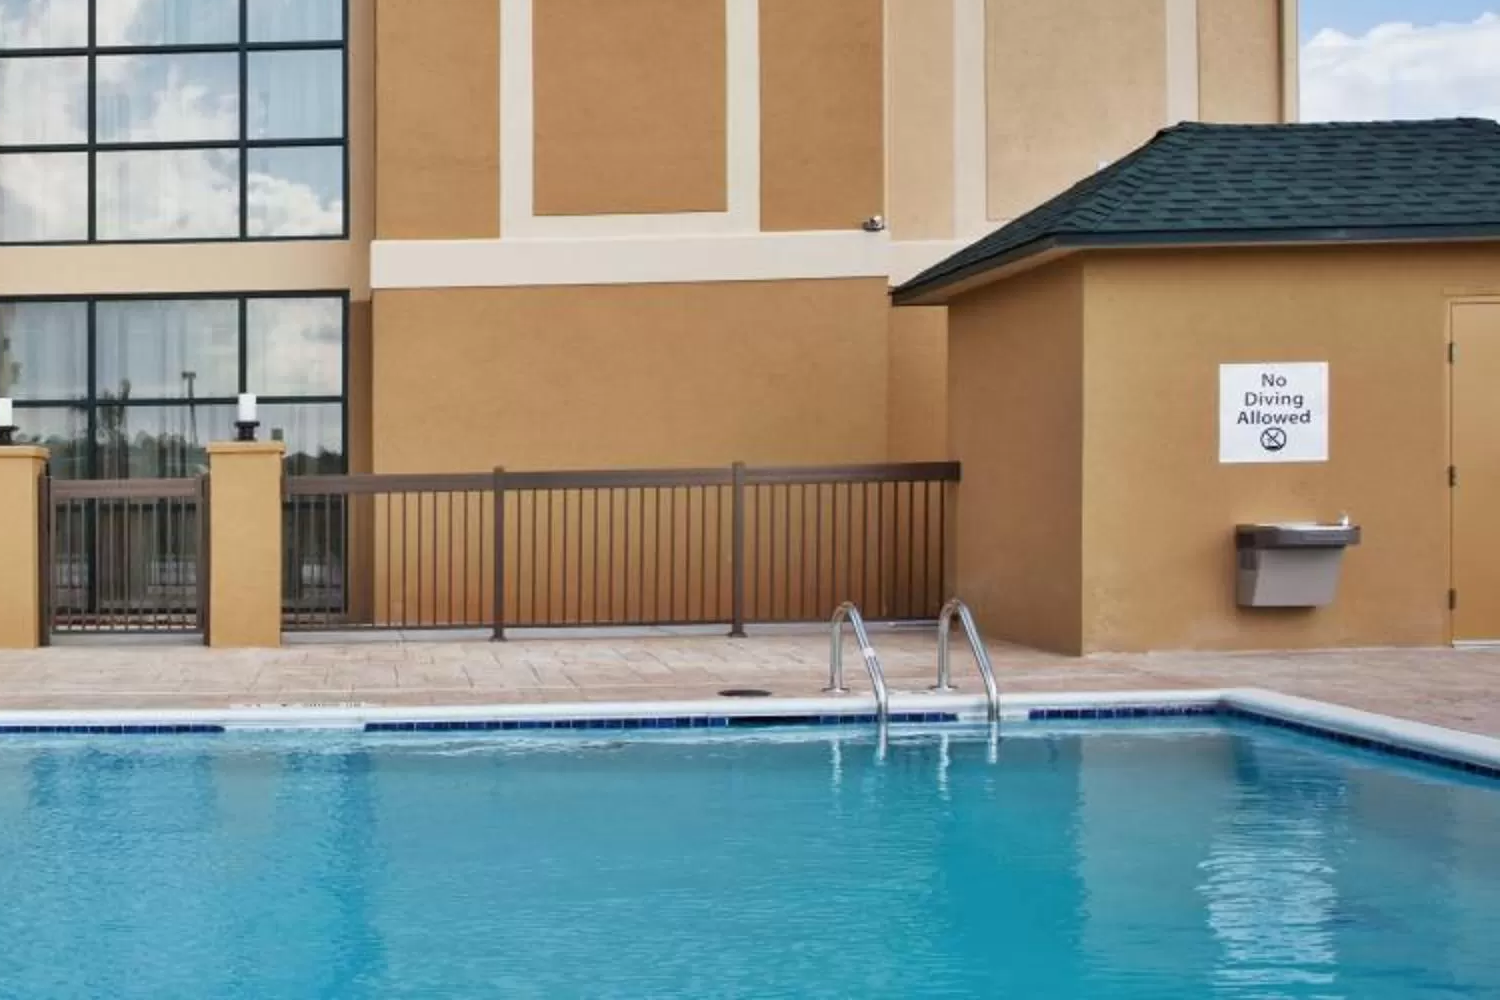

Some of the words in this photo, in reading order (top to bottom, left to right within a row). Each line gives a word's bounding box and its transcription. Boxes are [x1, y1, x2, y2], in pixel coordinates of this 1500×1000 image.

[1261, 373, 1287, 387] No
[1244, 391, 1304, 409] Diving
[1236, 410, 1311, 425] Allowed
